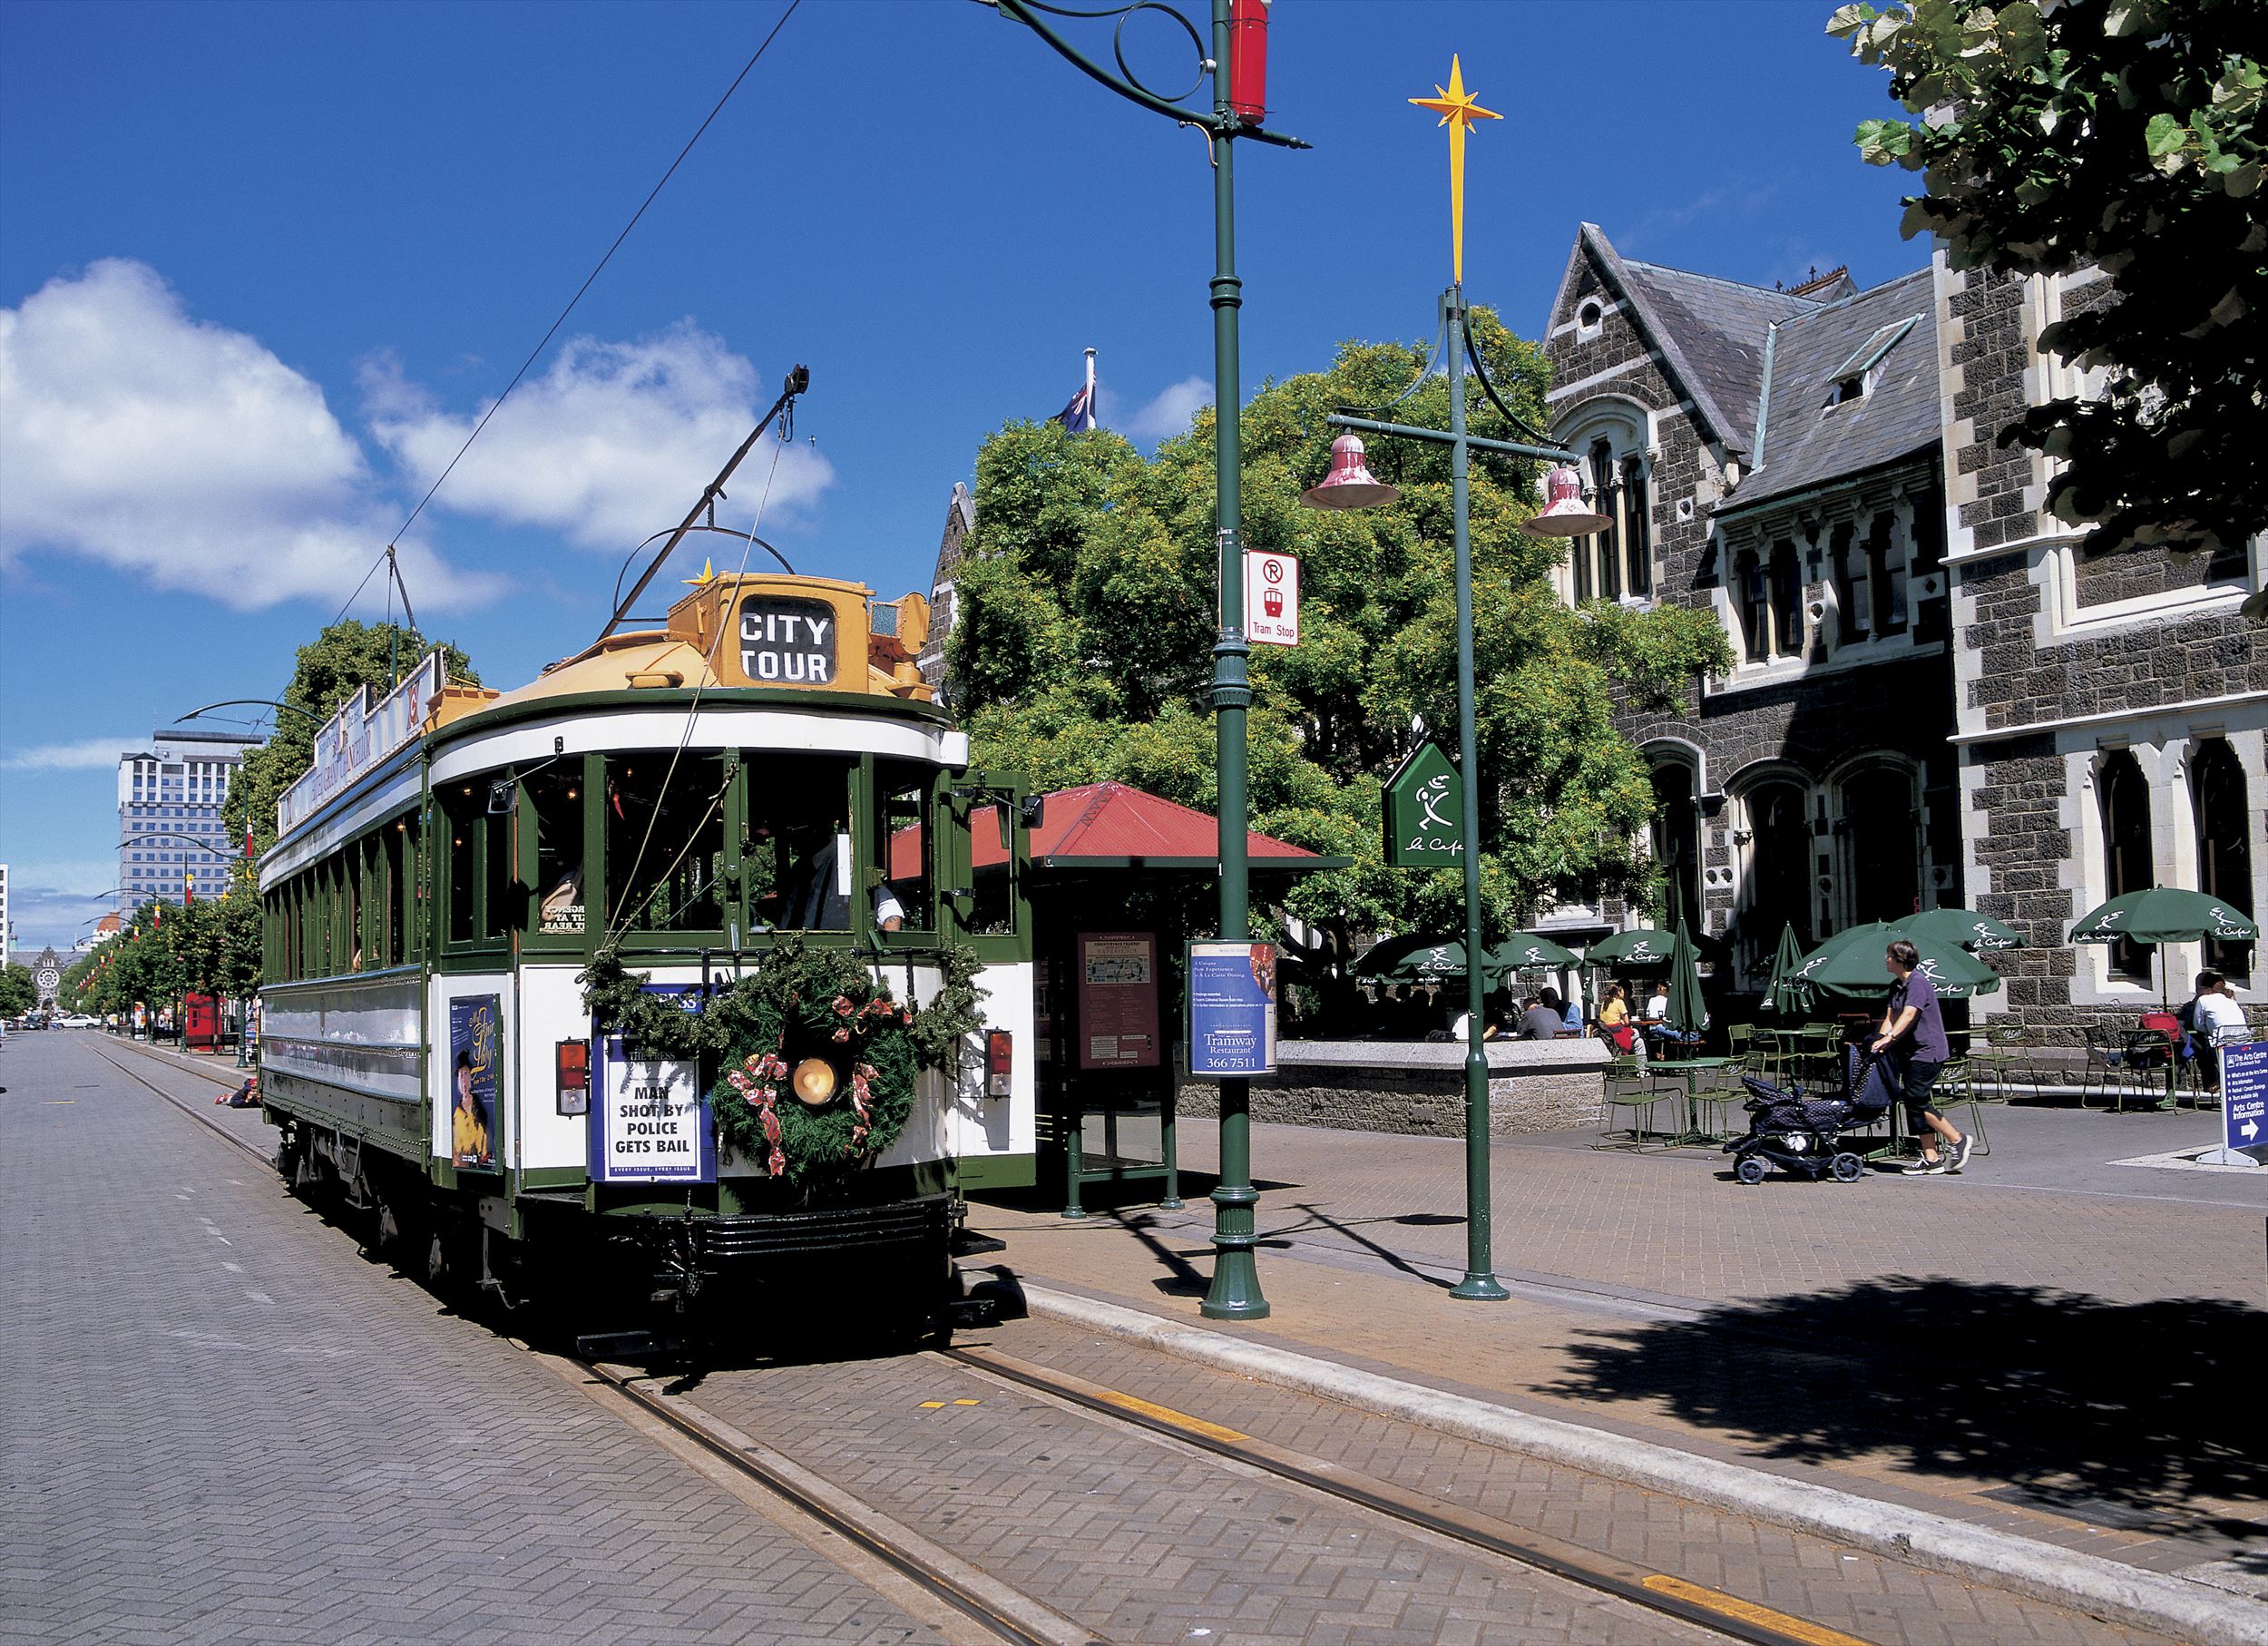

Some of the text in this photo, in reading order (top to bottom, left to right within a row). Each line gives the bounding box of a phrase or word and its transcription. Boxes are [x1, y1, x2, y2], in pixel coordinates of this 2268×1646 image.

[739, 612, 830, 645] CITY
[1253, 622, 1295, 639] Tram Stop
[740, 650, 828, 681] TOUR
[1405, 837, 1464, 857] le Cafe
[1204, 1034, 1257, 1049] Tramway
[629, 1052, 646, 1061] THE
[1210, 1046, 1251, 1054] Restaurant
[1207, 1057, 1256, 1068] 366 7511
[2244, 1053, 2253, 1062] Arts
[2253, 1052, 2268, 1060] Centre
[634, 1086, 670, 1100] MAN
[620, 1104, 684, 1118] SHOT BY
[2233, 1101, 2264, 1112] Arts Centre
[2233, 1108, 2265, 1121] Information
[627, 1122, 678, 1135] POLICE
[615, 1140, 689, 1153] GETS BAIL
